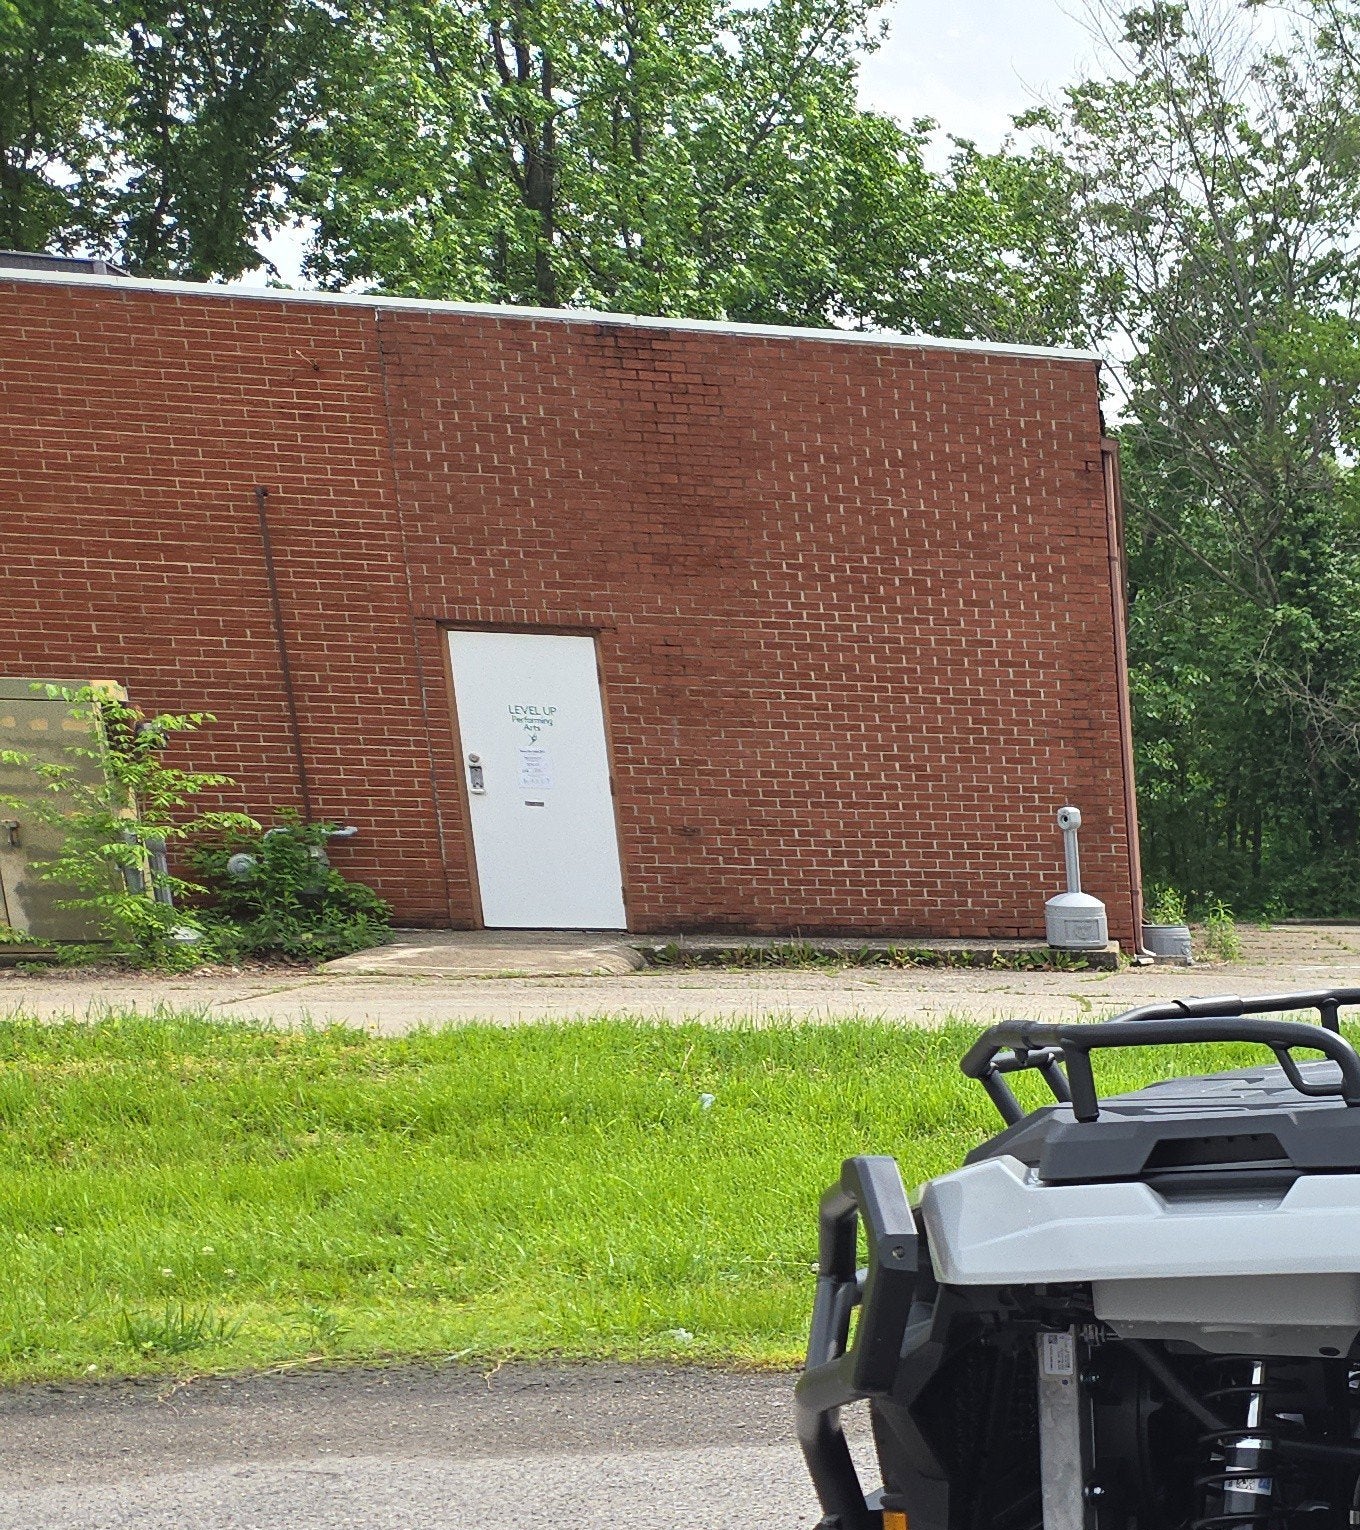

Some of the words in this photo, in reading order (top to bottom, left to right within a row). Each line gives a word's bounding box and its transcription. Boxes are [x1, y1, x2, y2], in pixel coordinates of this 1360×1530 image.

[508, 704, 541, 716] LEVEL
[542, 706, 557, 716] UP
[511, 714, 554, 727] Performing
